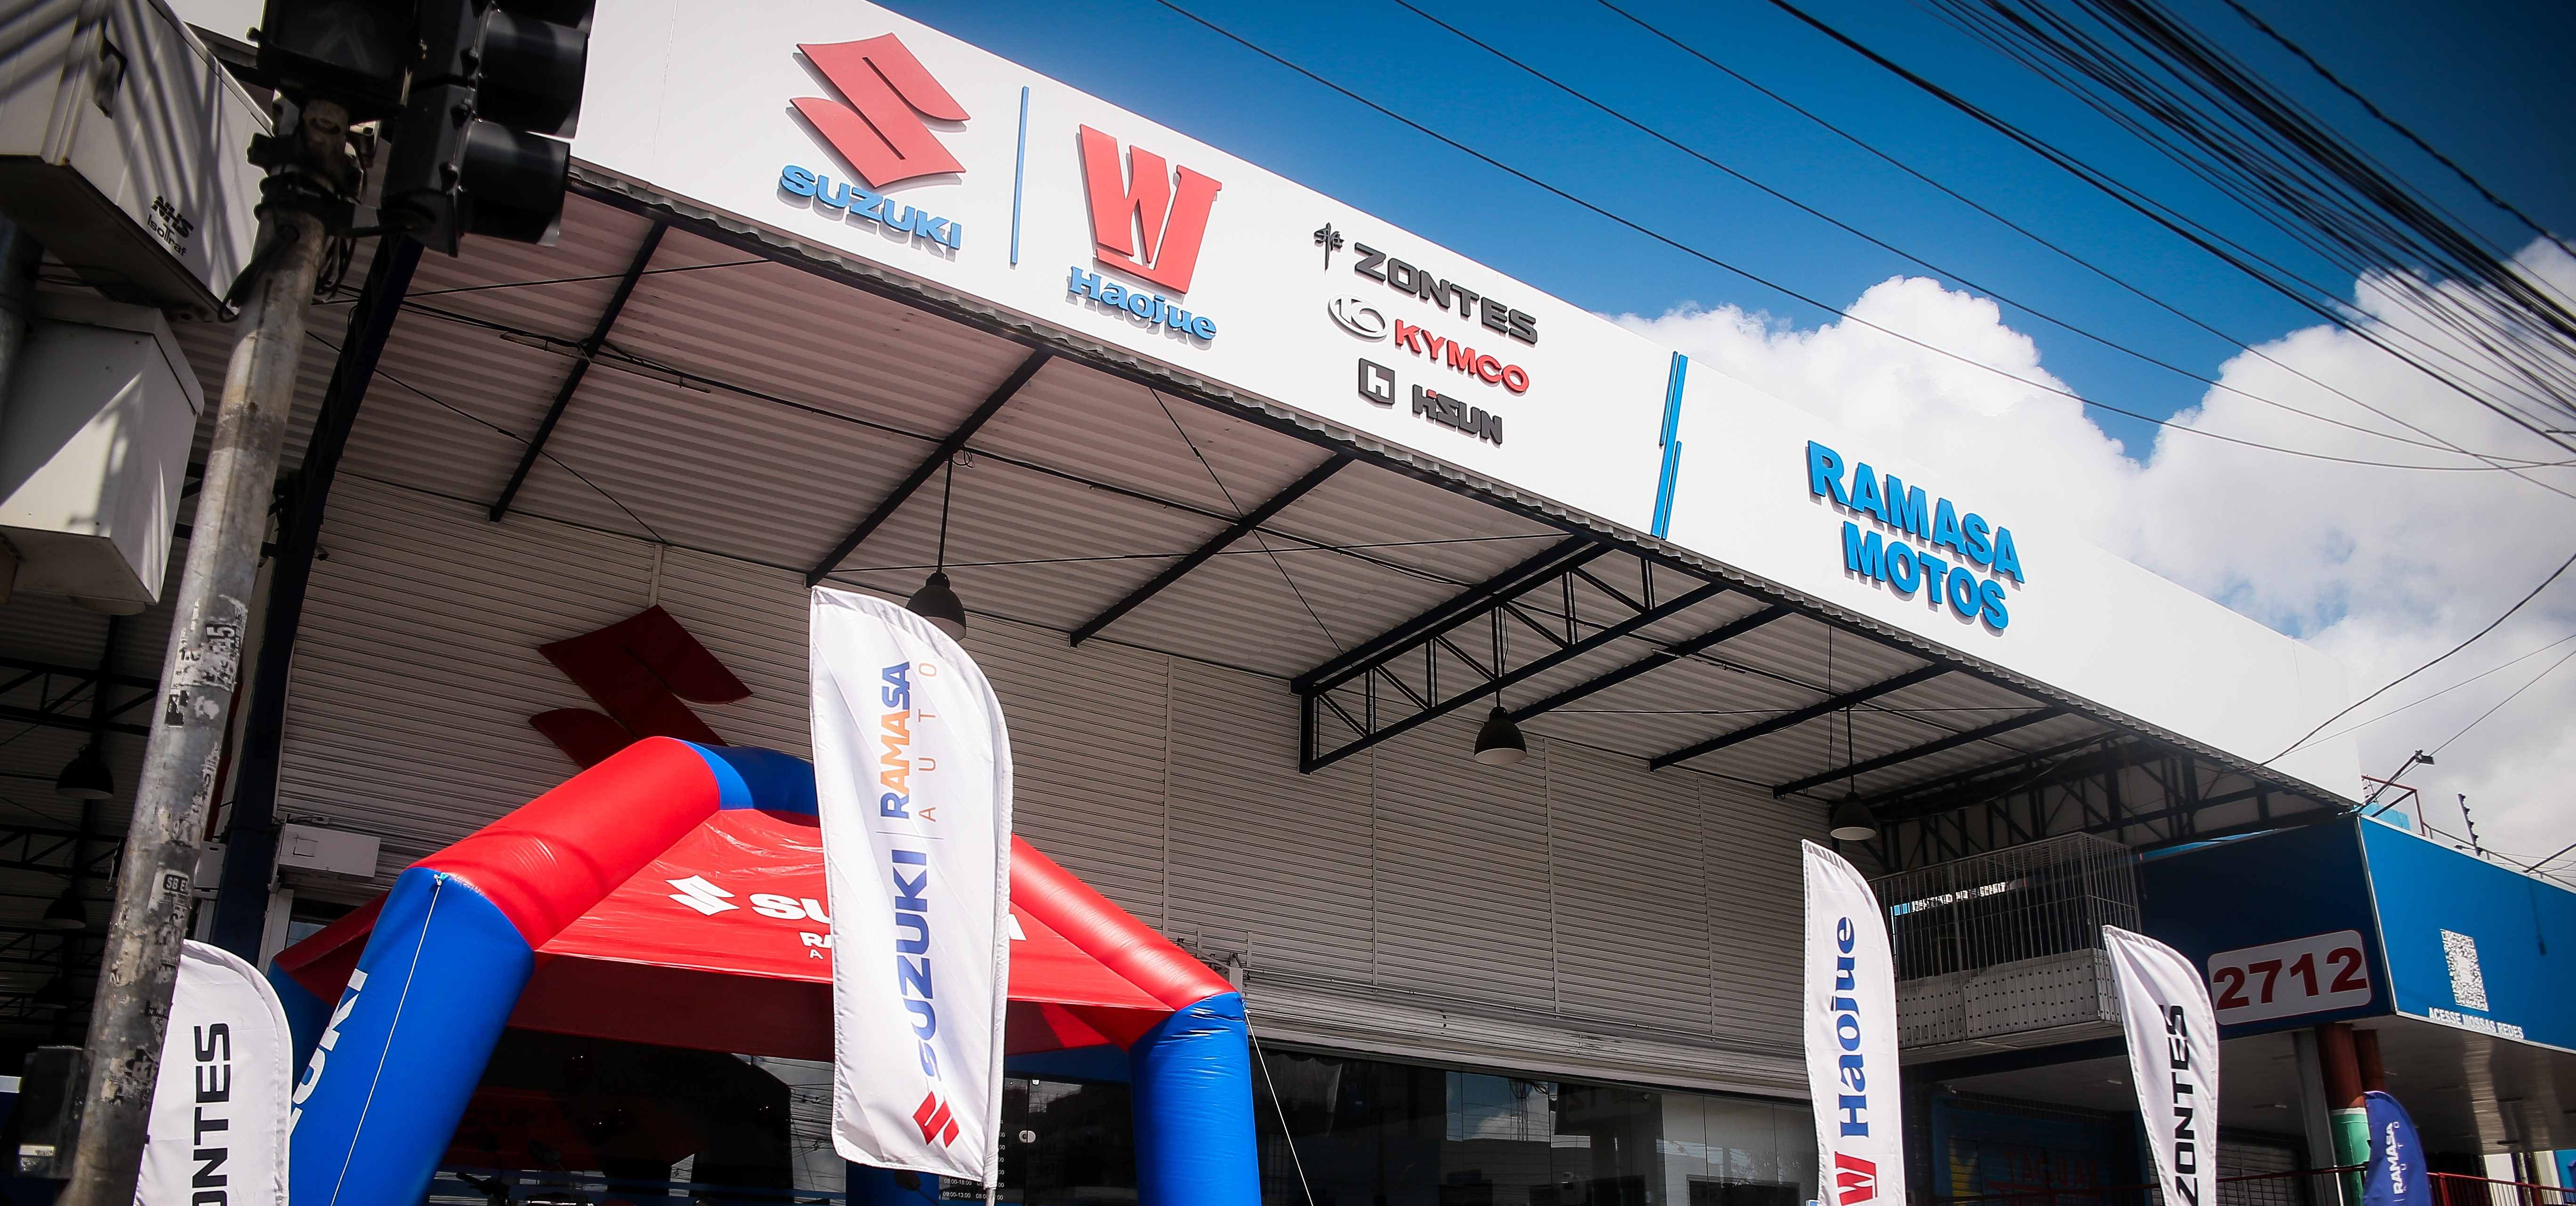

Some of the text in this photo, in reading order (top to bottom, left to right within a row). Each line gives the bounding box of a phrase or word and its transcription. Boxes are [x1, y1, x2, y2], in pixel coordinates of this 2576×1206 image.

[151, 196, 193, 238] NHS
[781, 165, 961, 250] SUZUKI
[1070, 266, 1217, 340] Haojue
[1354, 242, 1538, 345] ZONTES
[1395, 319, 1529, 393] KYMCO
[1806, 440, 2025, 584] RAMASA
[1843, 520, 2009, 630] MOTOS
[880, 661, 910, 819] RAMASA
[918, 662, 937, 822] AUTO
[892, 849, 942, 1082] SUZUKI
[2213, 947, 2368, 1011] 2712
[1830, 916, 1870, 1138] Haojue
[2428, 1007, 2524, 1039] ACESSE NOSSAS REDES
[2158, 1005, 2199, 1206] ZONTES
[2386, 1122, 2404, 1194] RAMASA
